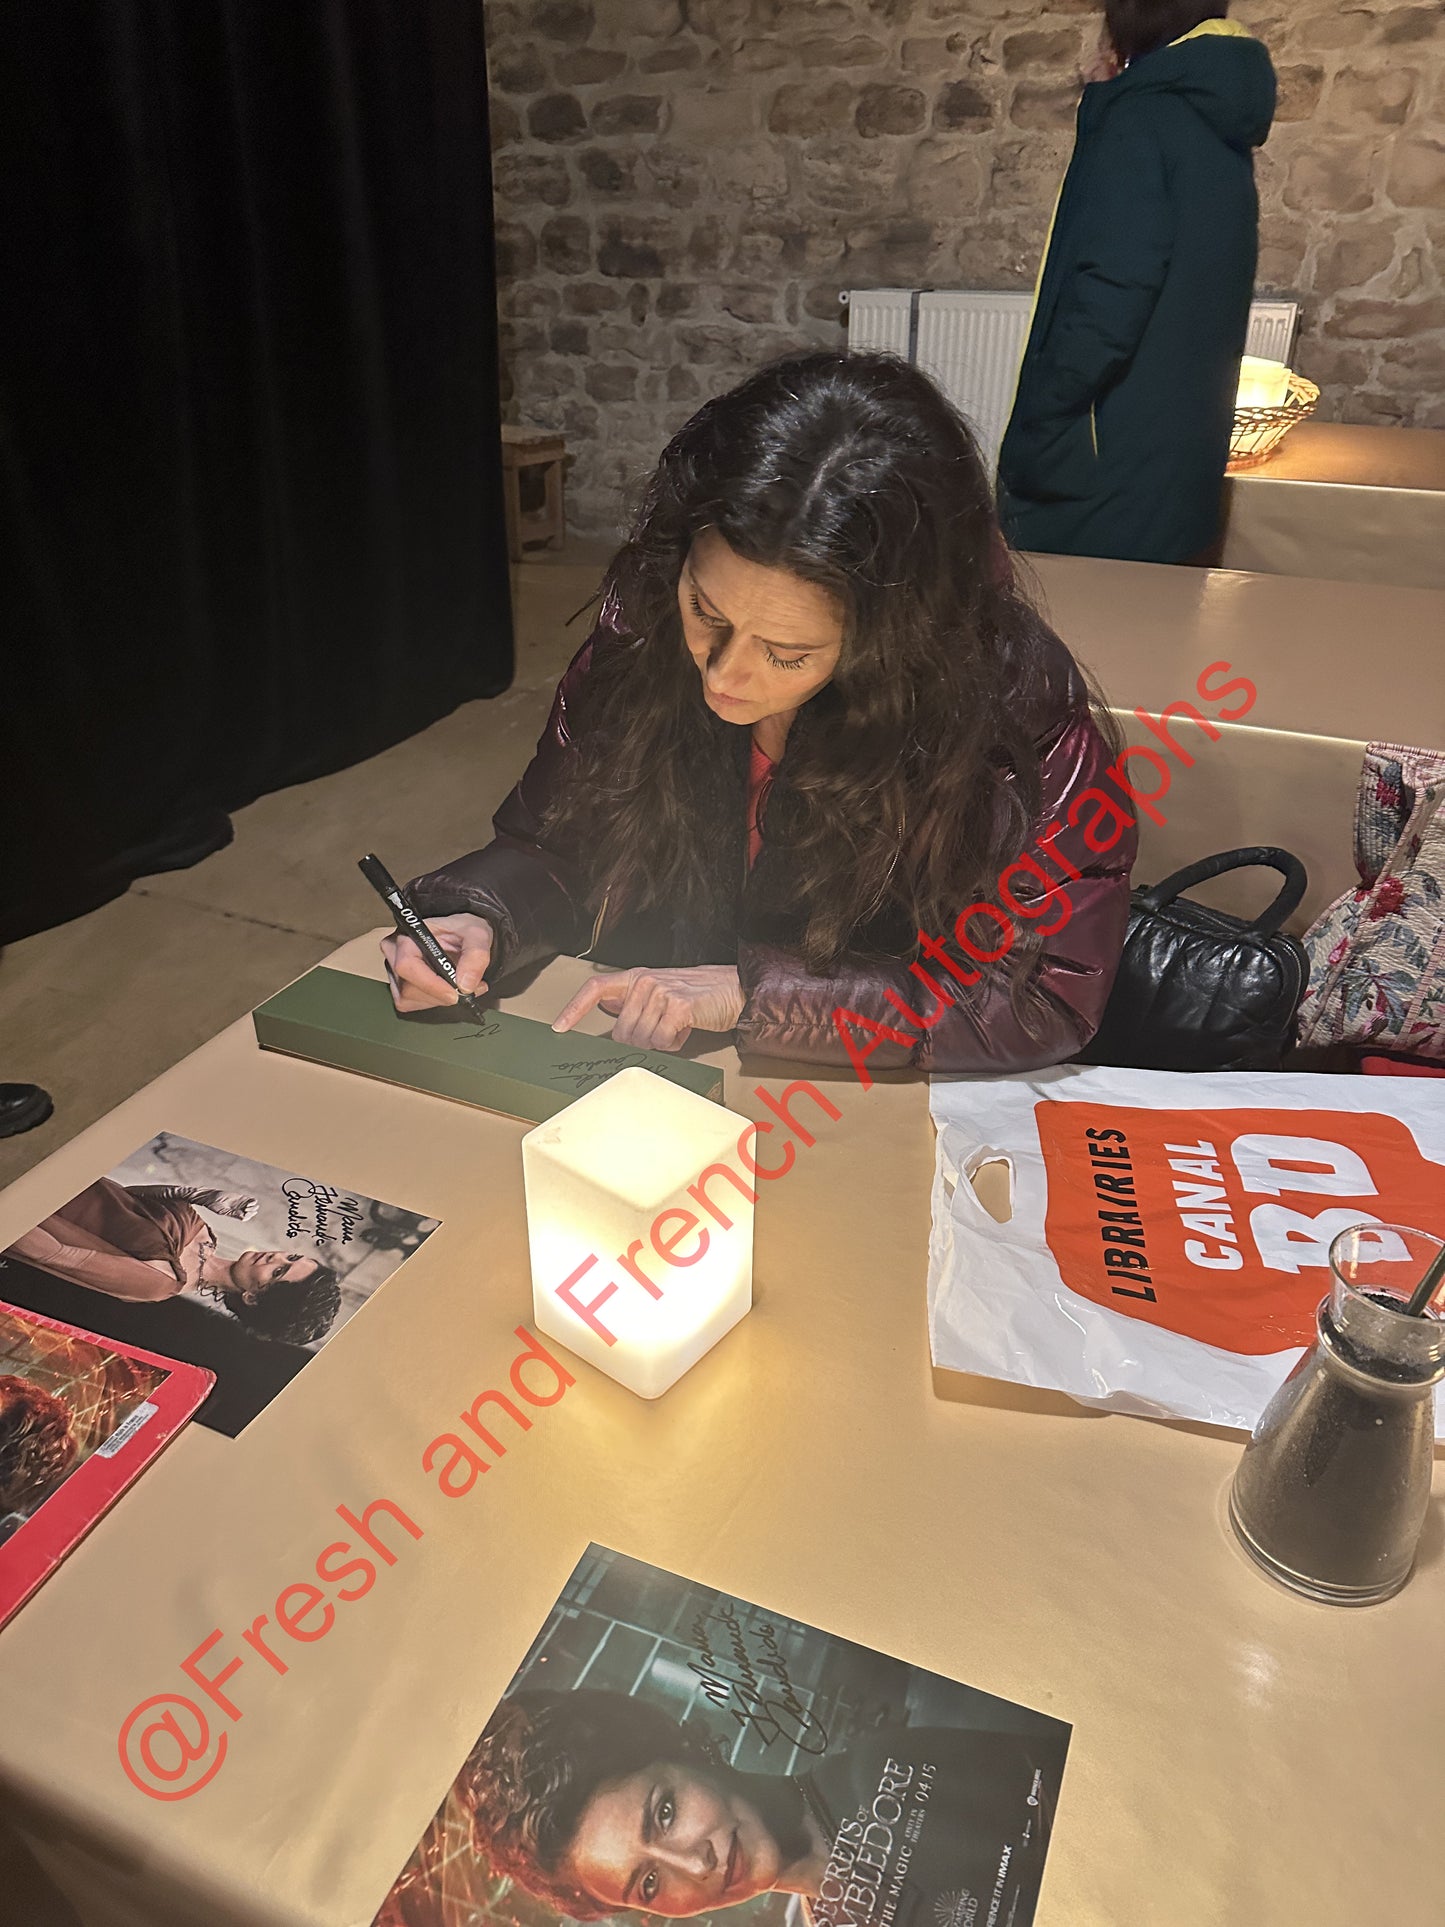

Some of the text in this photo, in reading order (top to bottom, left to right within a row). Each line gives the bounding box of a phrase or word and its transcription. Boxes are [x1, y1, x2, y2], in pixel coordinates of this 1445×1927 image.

[400, 908, 421, 929] 100
[416, 928, 438, 957] PERMANENT
[426, 936, 442, 959] MARKER
[1086, 1127, 1158, 1303] LIBRAIRIES
[1164, 1139, 1244, 1271] CANAL
[1231, 1133, 1414, 1274] BD
[914, 1763, 937, 1802] 04.15
[856, 1804, 870, 1823] OF
[904, 1808, 918, 1838] ONLY IN
[911, 1809, 926, 1843] THEATERS
[889, 1845, 913, 1897] MAGIC
[998, 1844, 1012, 1879] IMAX
[993, 1887, 1002, 1898] IT
[996, 1877, 1005, 1889] IN
